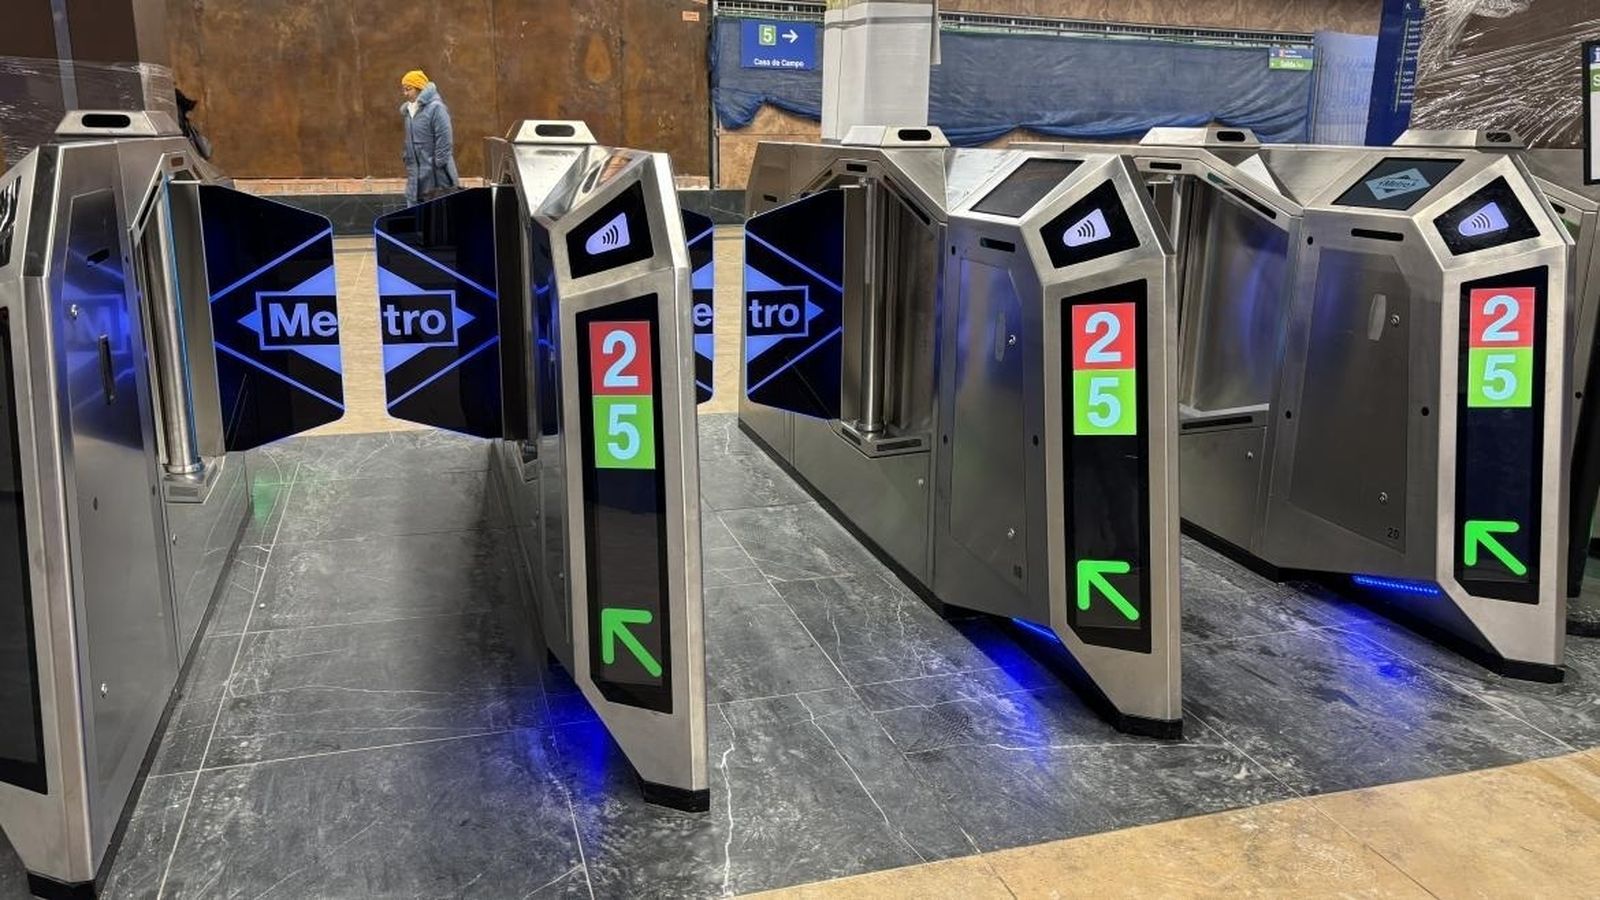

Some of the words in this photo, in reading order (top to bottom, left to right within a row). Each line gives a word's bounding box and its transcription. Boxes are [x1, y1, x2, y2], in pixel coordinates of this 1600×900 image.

[763, 27, 773, 43] 5
[781, 59, 804, 69] Campo
[1085, 311, 1122, 363] 2
[1482, 294, 1519, 342] 2
[603, 330, 639, 387] 2
[1482, 354, 1517, 401] 5
[1087, 377, 1121, 428] 5
[607, 404, 640, 460] 5
